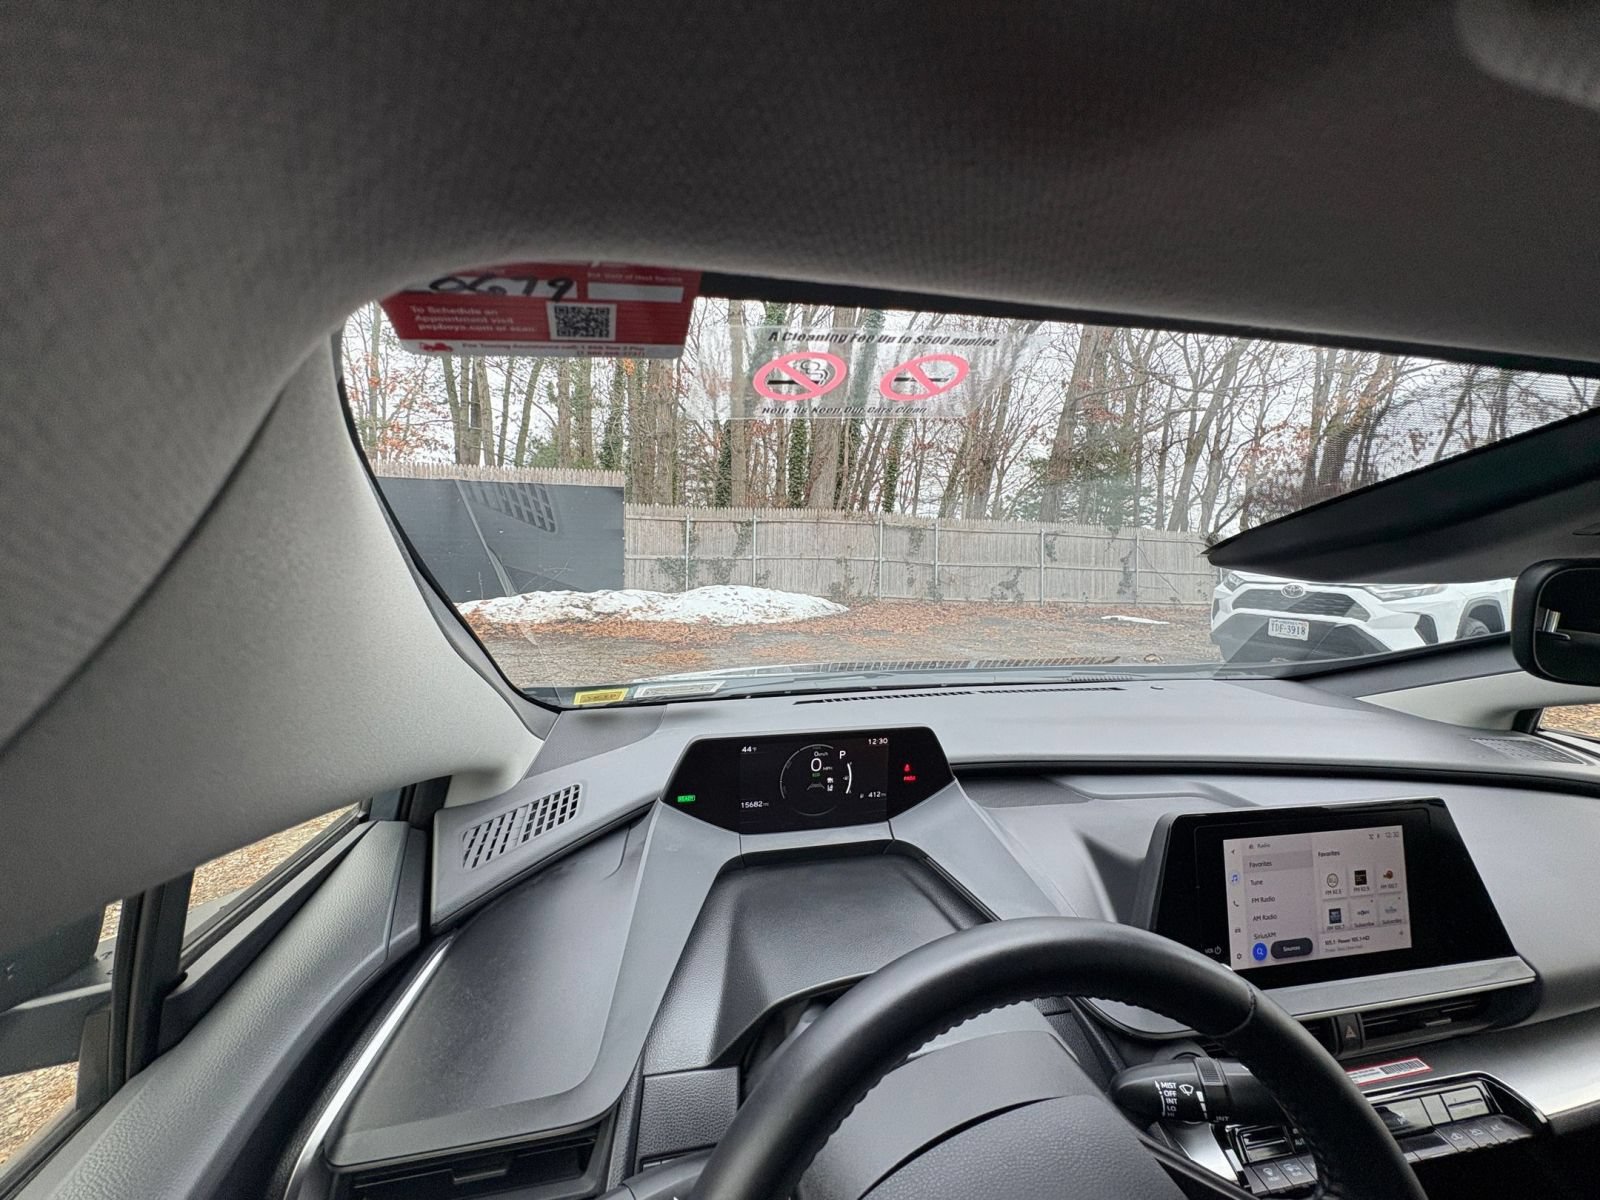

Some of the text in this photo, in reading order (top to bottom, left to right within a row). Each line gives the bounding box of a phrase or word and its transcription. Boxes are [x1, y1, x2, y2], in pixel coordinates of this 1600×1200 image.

[427, 305, 482, 315] Schedule
[415, 315, 488, 325] Appointment
[768, 331, 999, 347] A Cleaning Fee Up to $500 applies
[839, 750, 846, 759] P
[811, 758, 822, 772] 0
[1160, 1081, 1177, 1089] MIST
[1165, 1097, 1178, 1105] INT
